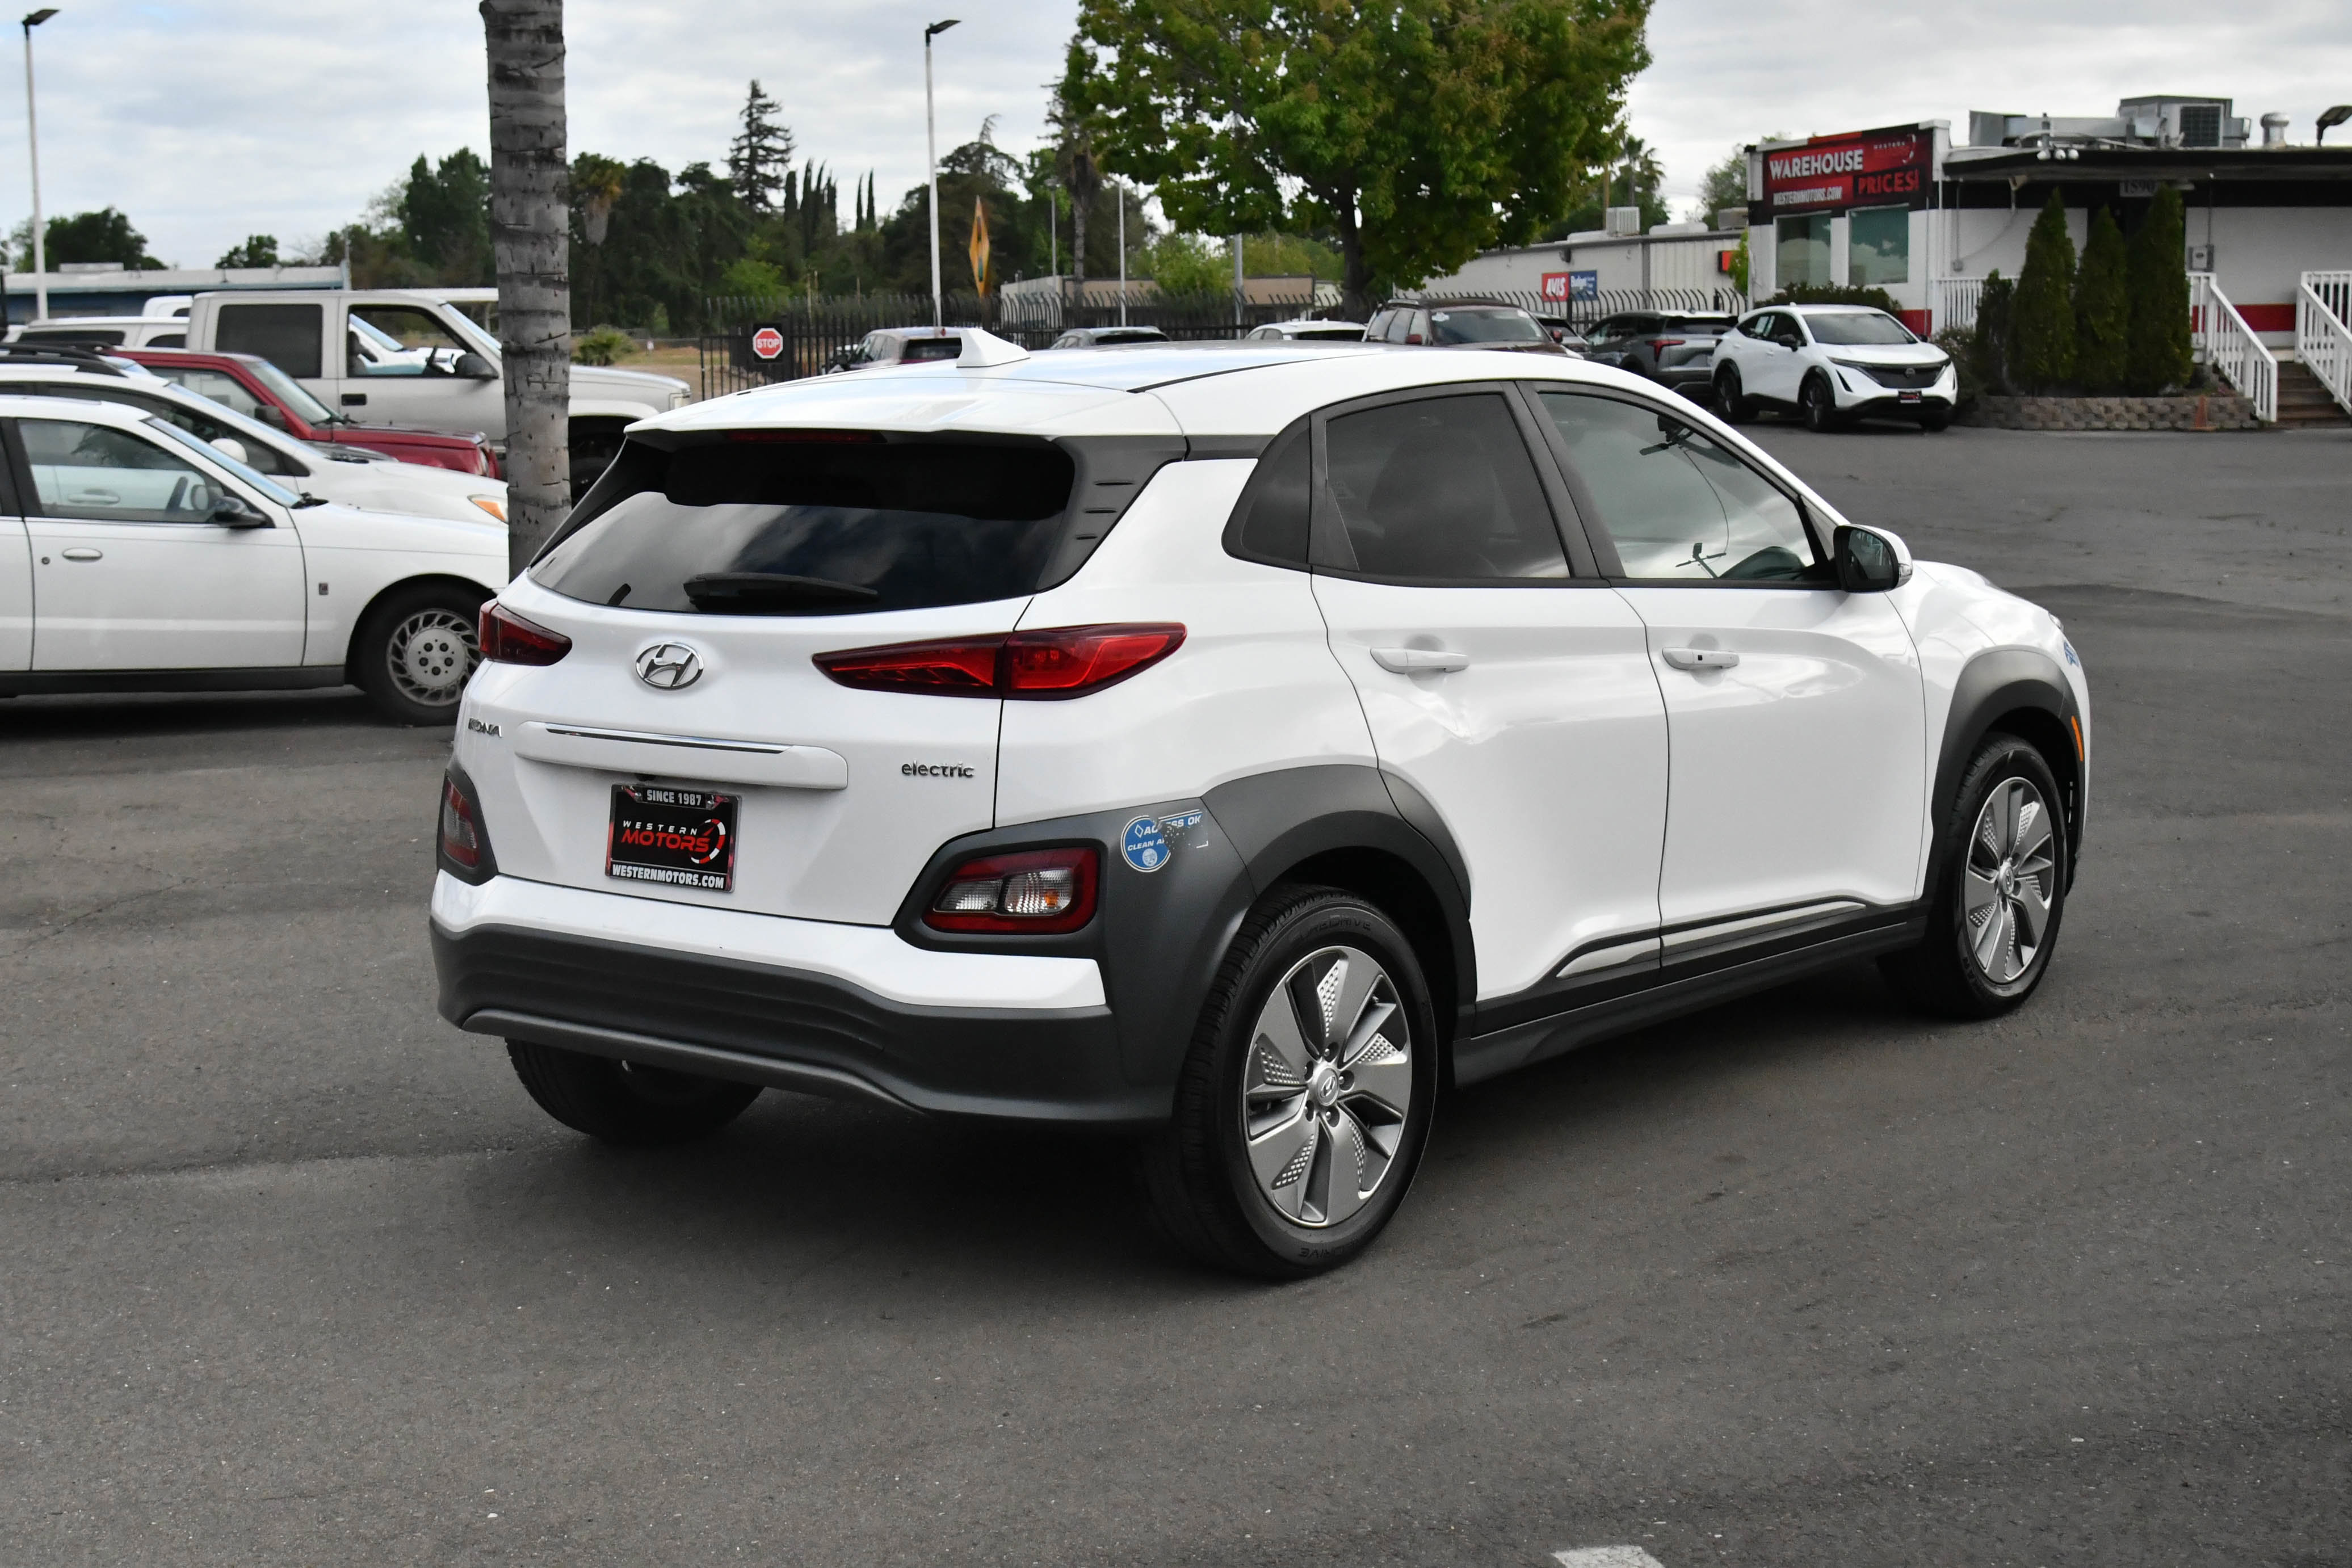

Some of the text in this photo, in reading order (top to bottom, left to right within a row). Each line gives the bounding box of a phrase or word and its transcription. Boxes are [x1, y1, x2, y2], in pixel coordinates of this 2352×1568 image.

[1769, 149, 1864, 180] WAREHOUSE
[1858, 169, 1920, 195] PRICES!
[1546, 277, 1566, 297] AVIS
[757, 338, 780, 348] STOP
[468, 717, 503, 738] KONA
[901, 759, 975, 779] electric
[646, 789, 702, 806] SINCE 1987
[623, 819, 698, 836] WESTERN
[1144, 814, 1202, 836] ACSS OK
[621, 829, 711, 854] MOTORS
[1127, 839, 1154, 852] CLEAN
[612, 863, 725, 889] WESTERNMOTORS.COM
